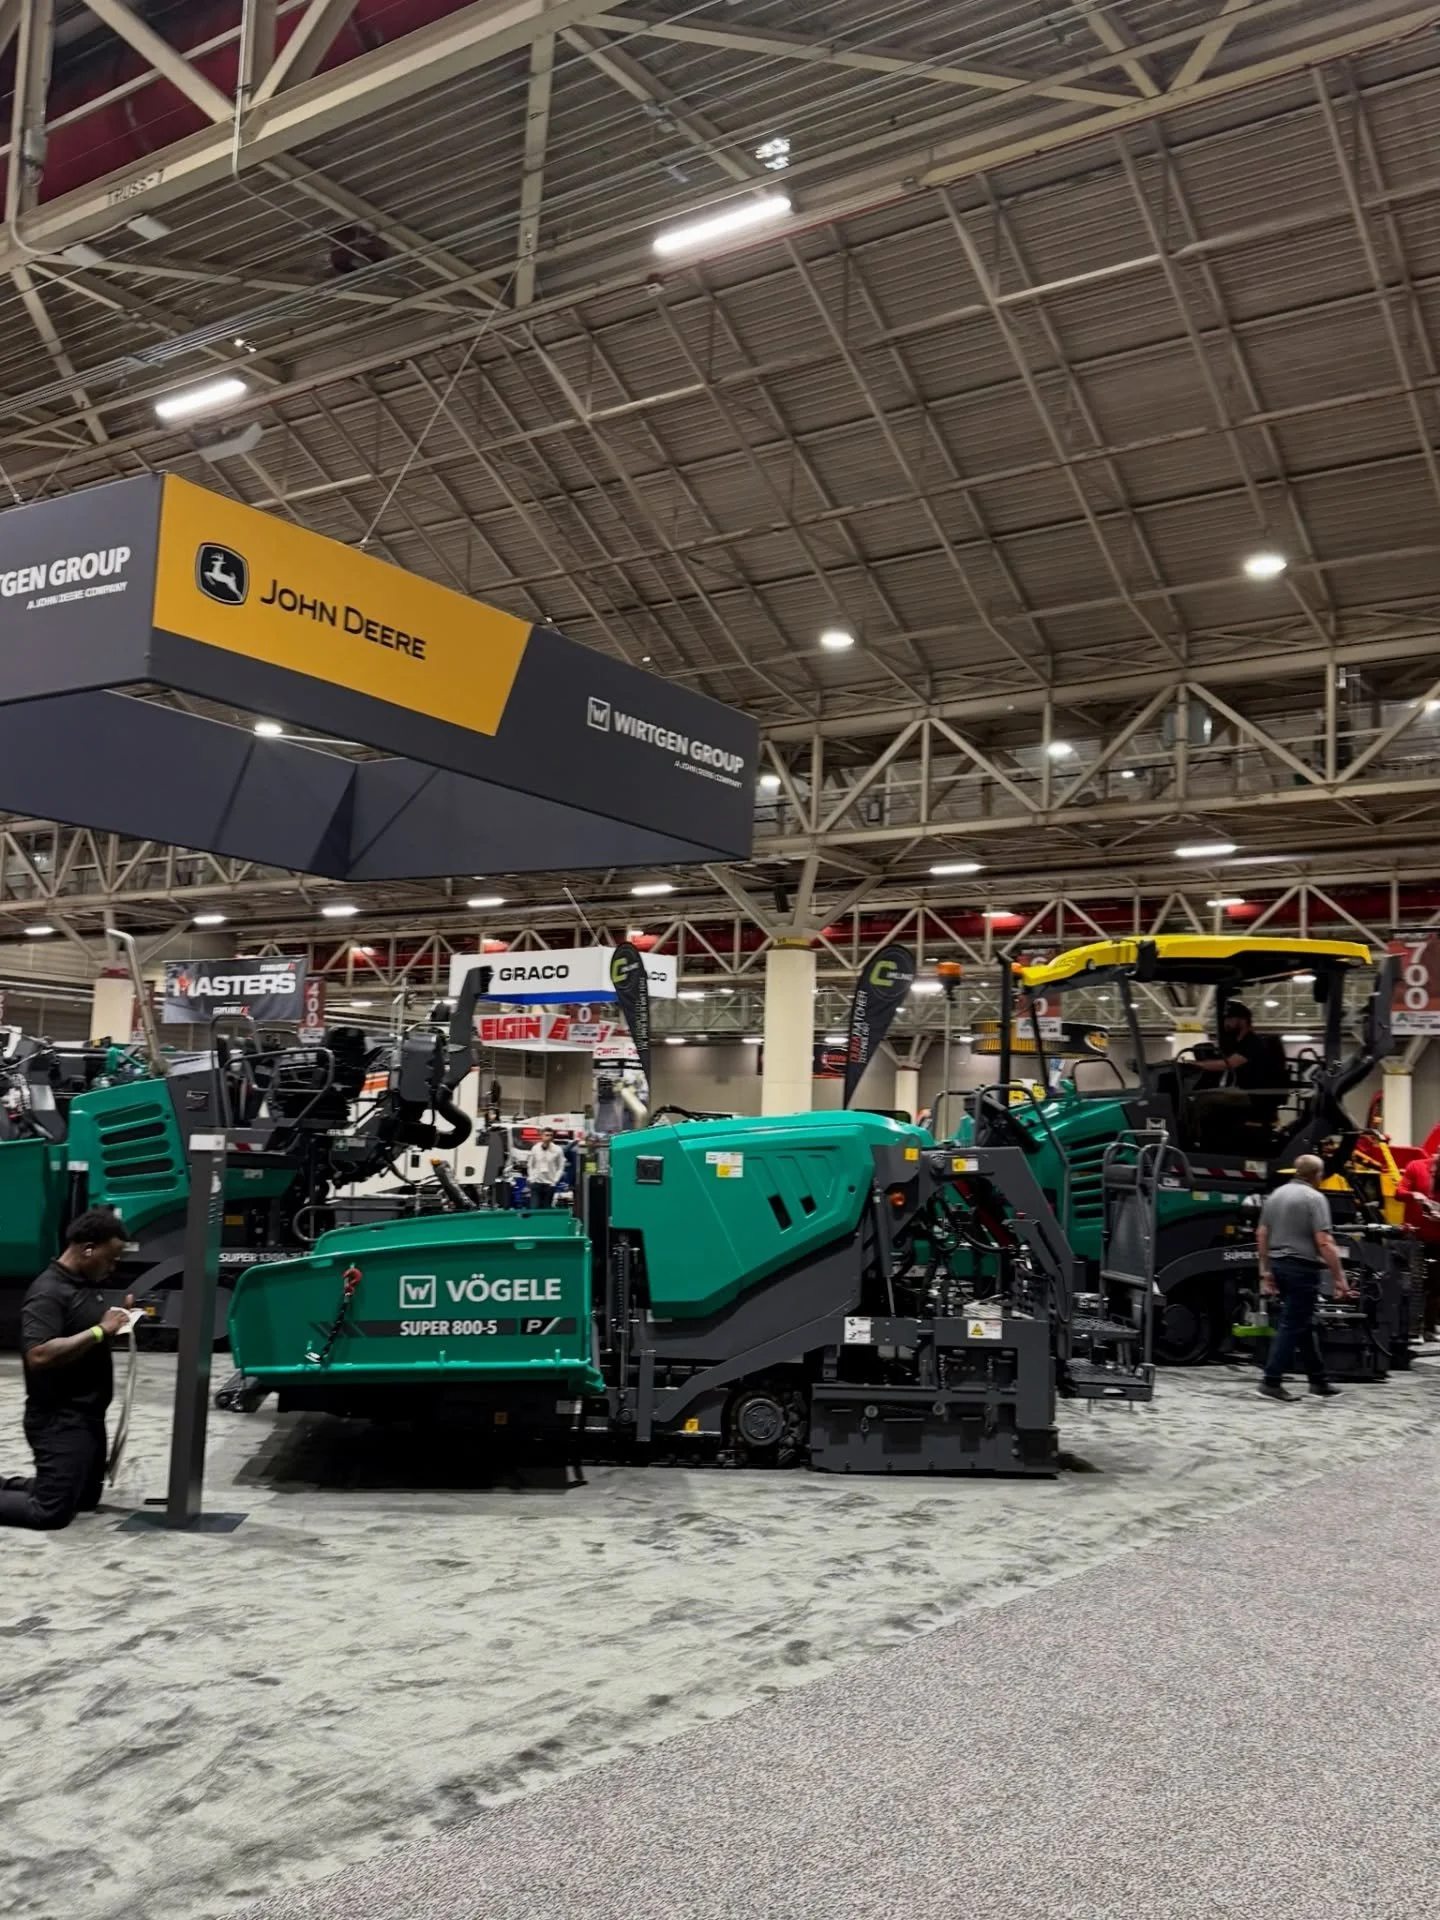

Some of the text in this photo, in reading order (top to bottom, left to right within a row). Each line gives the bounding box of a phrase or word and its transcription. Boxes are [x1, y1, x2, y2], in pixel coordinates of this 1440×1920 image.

[49, 546, 131, 586] GROUP
[85, 581, 128, 597] COMPANY
[260, 579, 427, 660] JOHN DEERE
[614, 711, 689, 755] WIRTGEN
[690, 741, 744, 773] GROUP
[499, 965, 570, 981] GRACO
[1404, 942, 1429, 1010] 700
[306, 983, 319, 1027] 400
[481, 1016, 541, 1040] ELGIN
[219, 1253, 258, 1262] SUPER
[445, 1273, 562, 1302] VÖGELE
[400, 1320, 450, 1336] SUPER
[452, 1320, 498, 1335] 800-5
